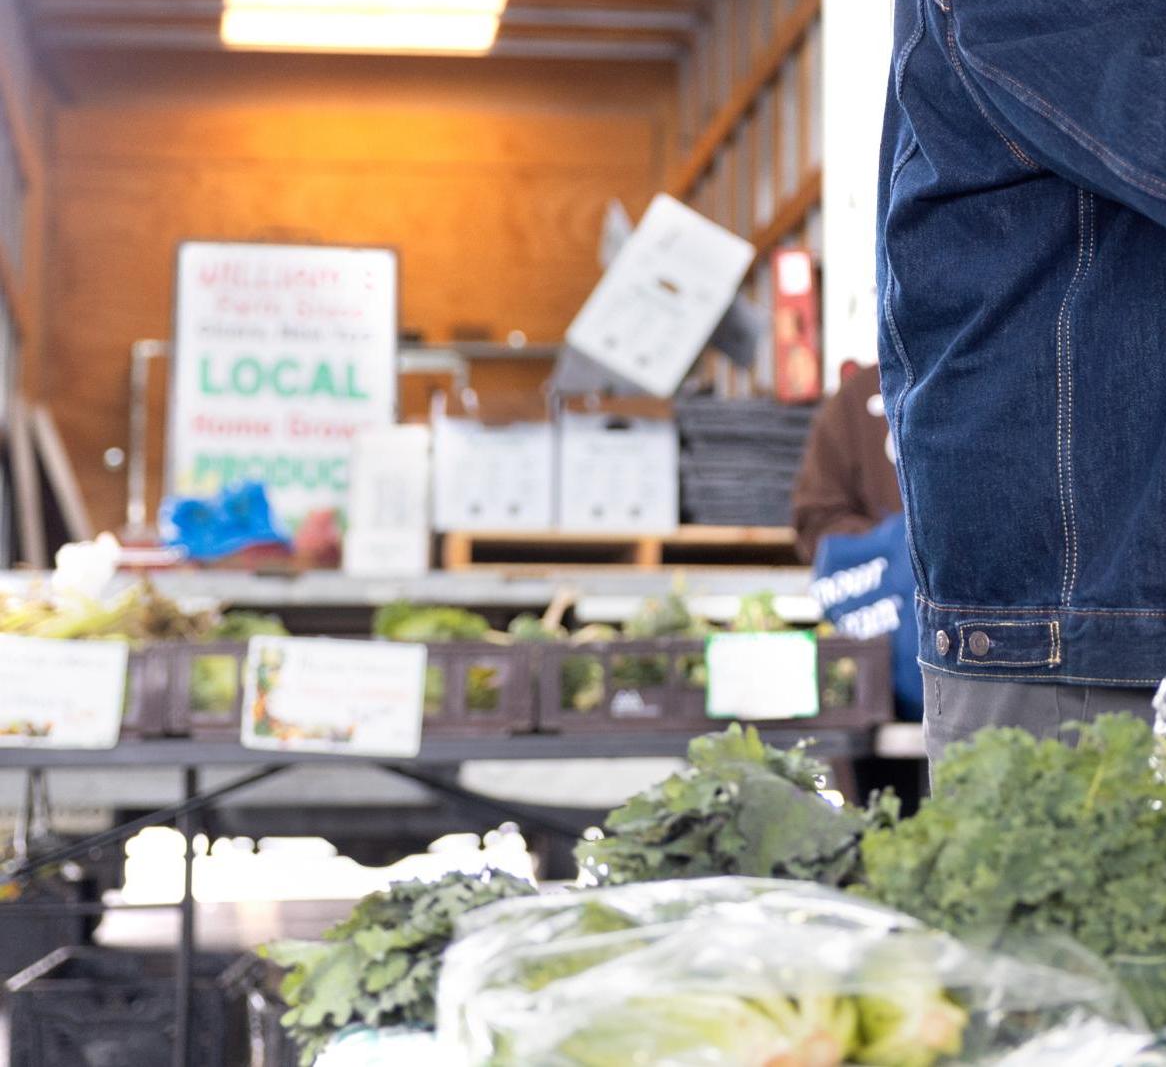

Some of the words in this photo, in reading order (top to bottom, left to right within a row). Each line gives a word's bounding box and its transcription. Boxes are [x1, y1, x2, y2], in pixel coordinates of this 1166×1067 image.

[199, 355, 369, 400] LOCAL
[289, 411, 362, 439] Grow
[195, 453, 350, 491] PRODUC
